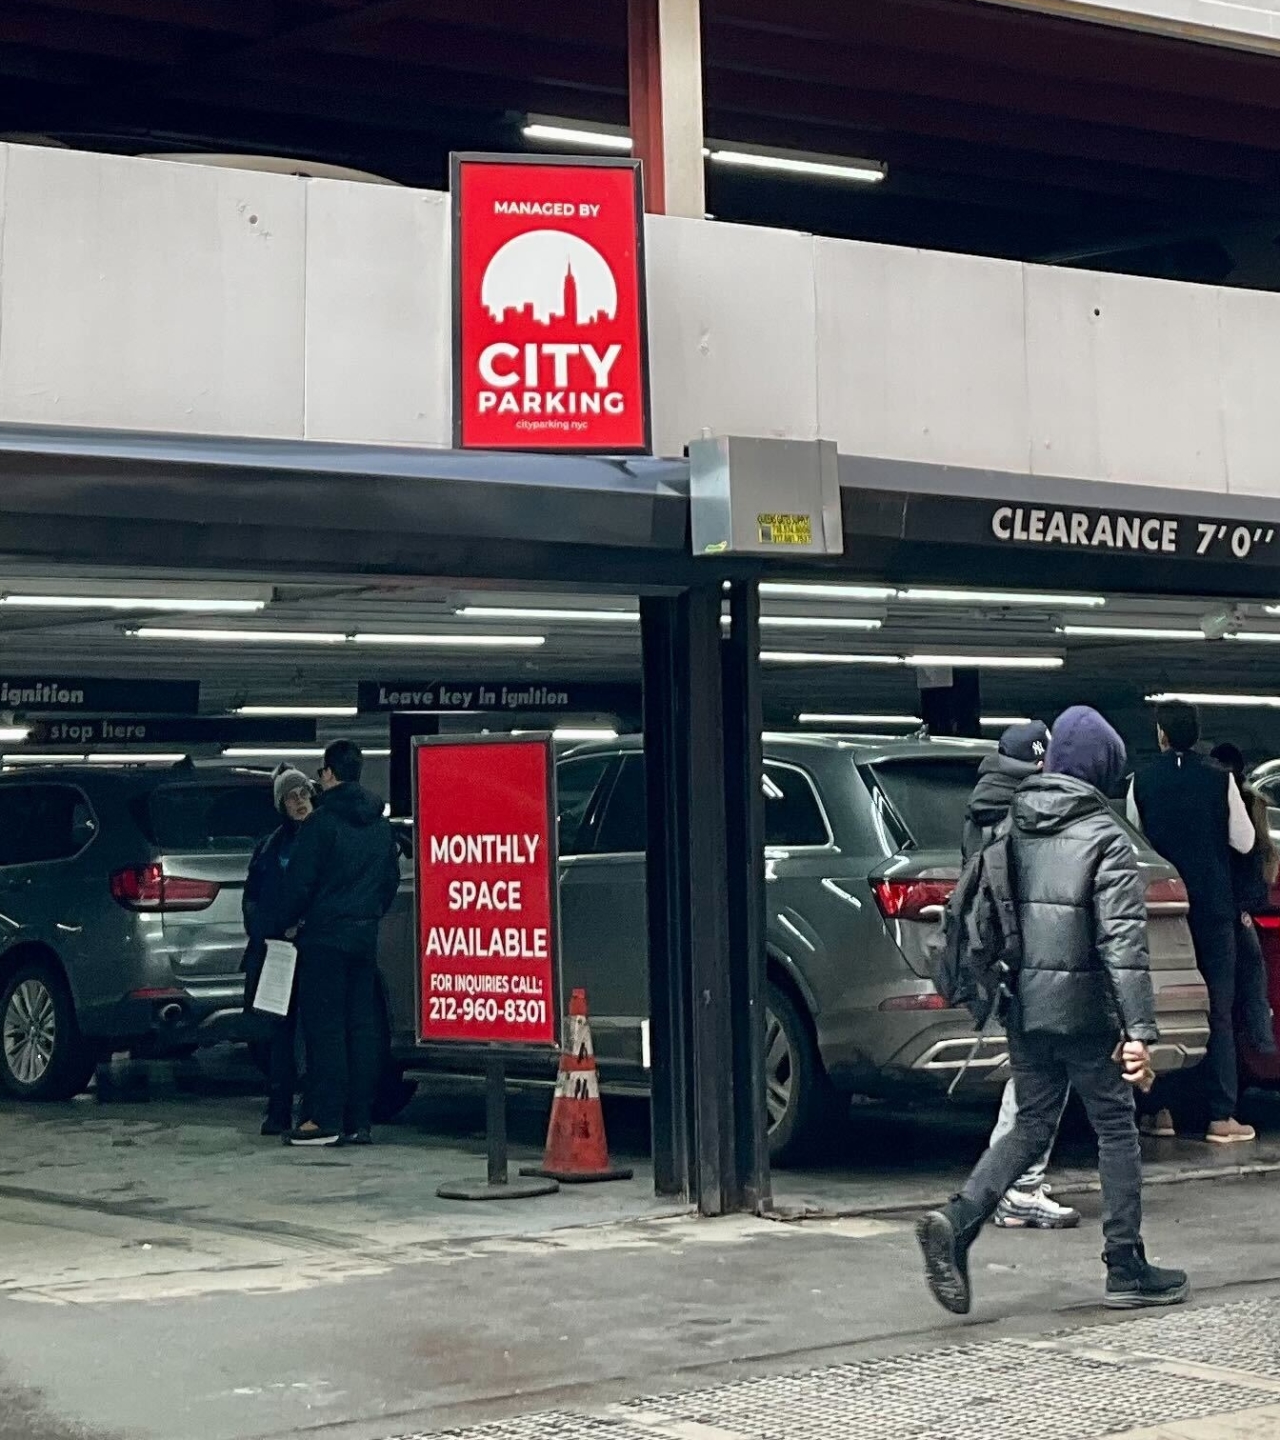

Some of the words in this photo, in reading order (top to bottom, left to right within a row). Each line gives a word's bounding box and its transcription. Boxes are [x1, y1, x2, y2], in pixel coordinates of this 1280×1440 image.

[494, 200, 574, 217] MANAGED
[579, 203, 600, 217] BY
[478, 342, 622, 388] CITY
[478, 391, 625, 415] PARKING
[991, 506, 1179, 552] CLEARANCE
[1, 682, 84, 707] ignition
[378, 686, 435, 705] Leave
[439, 685, 473, 709] key
[501, 686, 568, 708] ignition
[51, 722, 93, 741] stop
[102, 719, 146, 739] here
[429, 833, 540, 864] MONTHLY
[448, 880, 522, 911] SPACE
[425, 926, 548, 958] AVAILABLE
[430, 973, 453, 992] FOR
[454, 973, 510, 996] INQUIRIES
[510, 975, 543, 996] CALL:
[428, 996, 546, 1024] 212-960-8301
